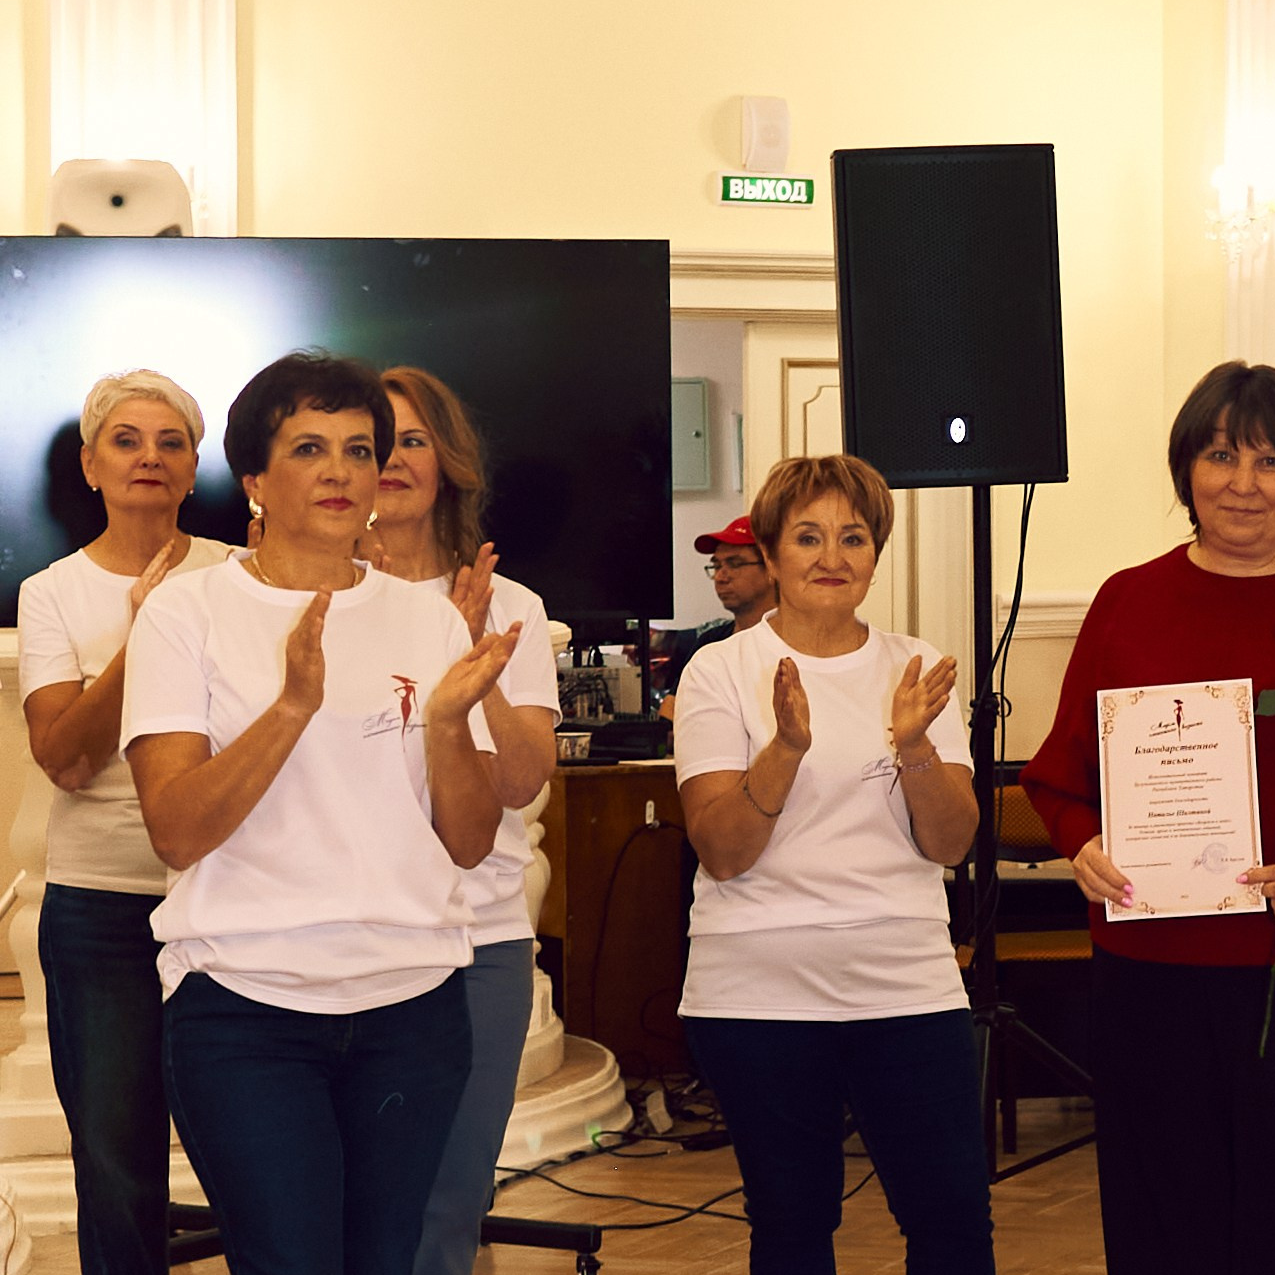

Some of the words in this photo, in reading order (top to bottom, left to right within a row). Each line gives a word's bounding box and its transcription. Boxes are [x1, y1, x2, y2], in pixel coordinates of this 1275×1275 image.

[729, 178, 807, 202] ВЫХОД
[1134, 742, 1219, 755] Благодарственное
[1160, 757, 1194, 766] письмо
